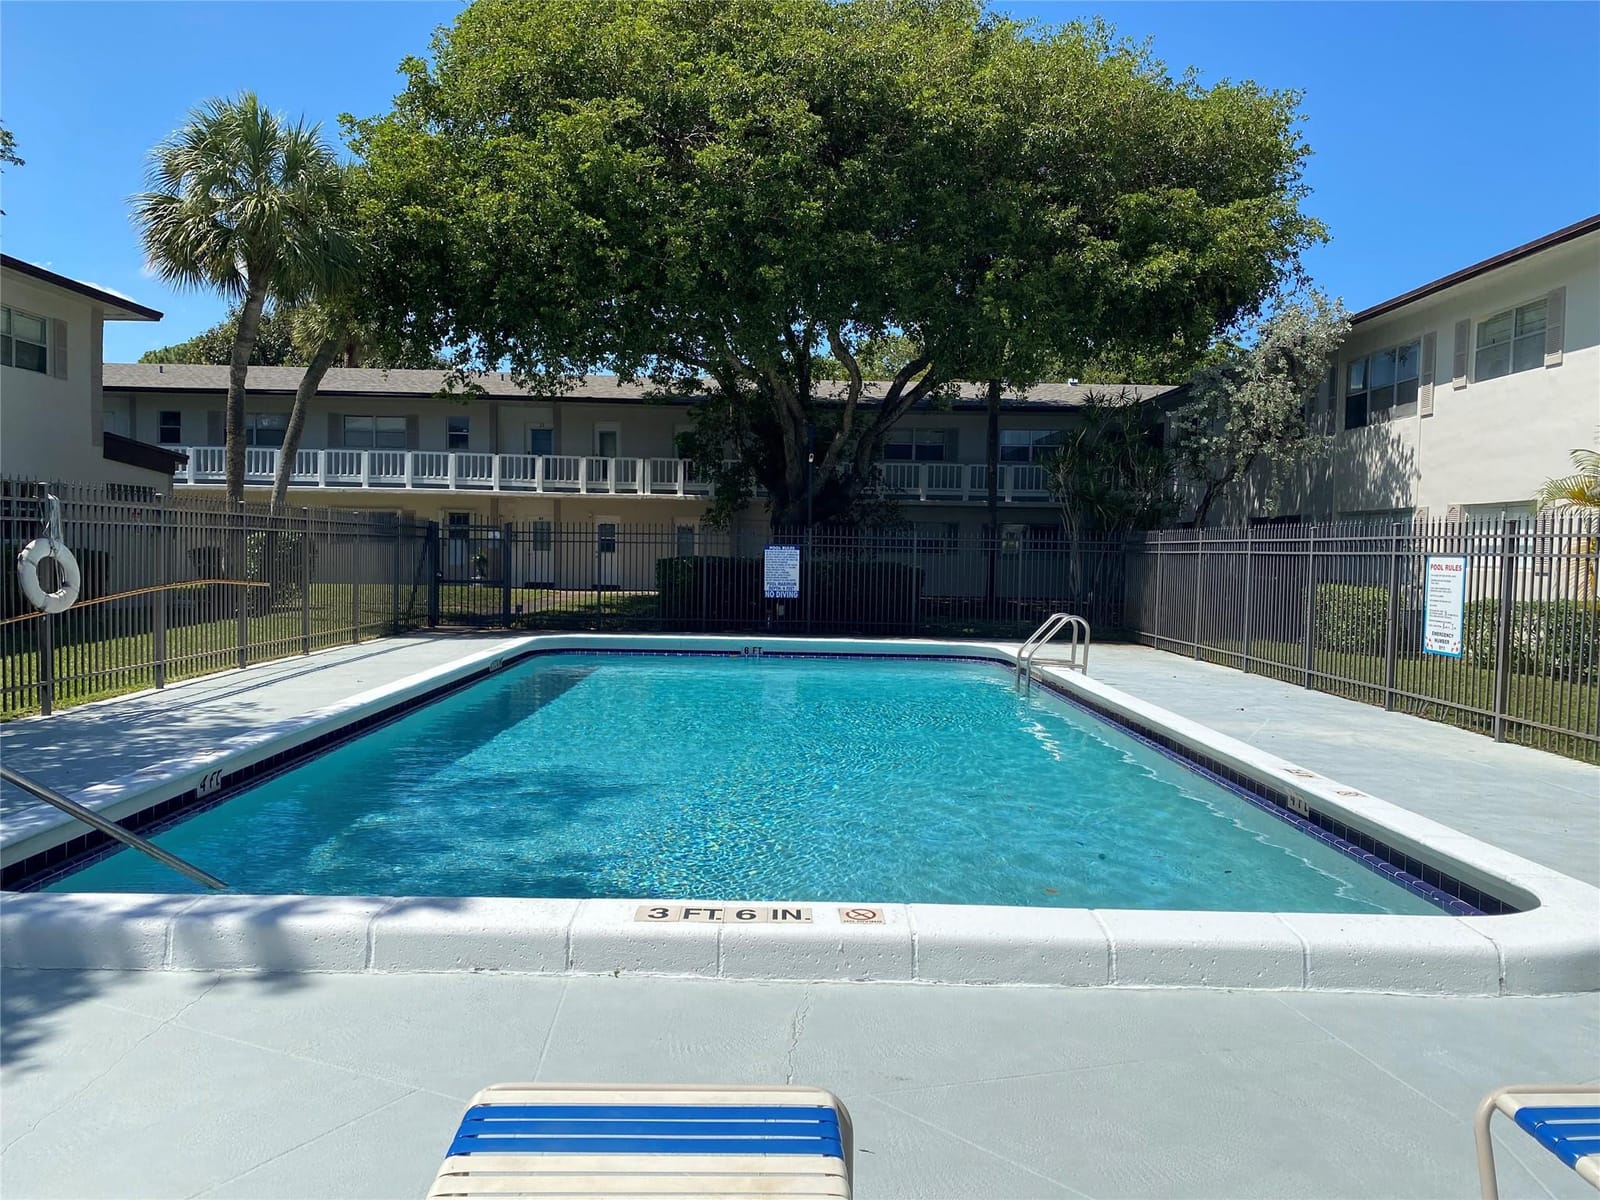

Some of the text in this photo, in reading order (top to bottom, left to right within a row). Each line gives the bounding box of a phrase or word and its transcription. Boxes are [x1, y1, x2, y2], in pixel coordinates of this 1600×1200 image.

[1445, 564, 1462, 572] RULES
[1432, 630, 1454, 638] EMERGENCY
[200, 774, 209, 792] 4
[648, 907, 811, 921] 3 FT. 6 IN.
